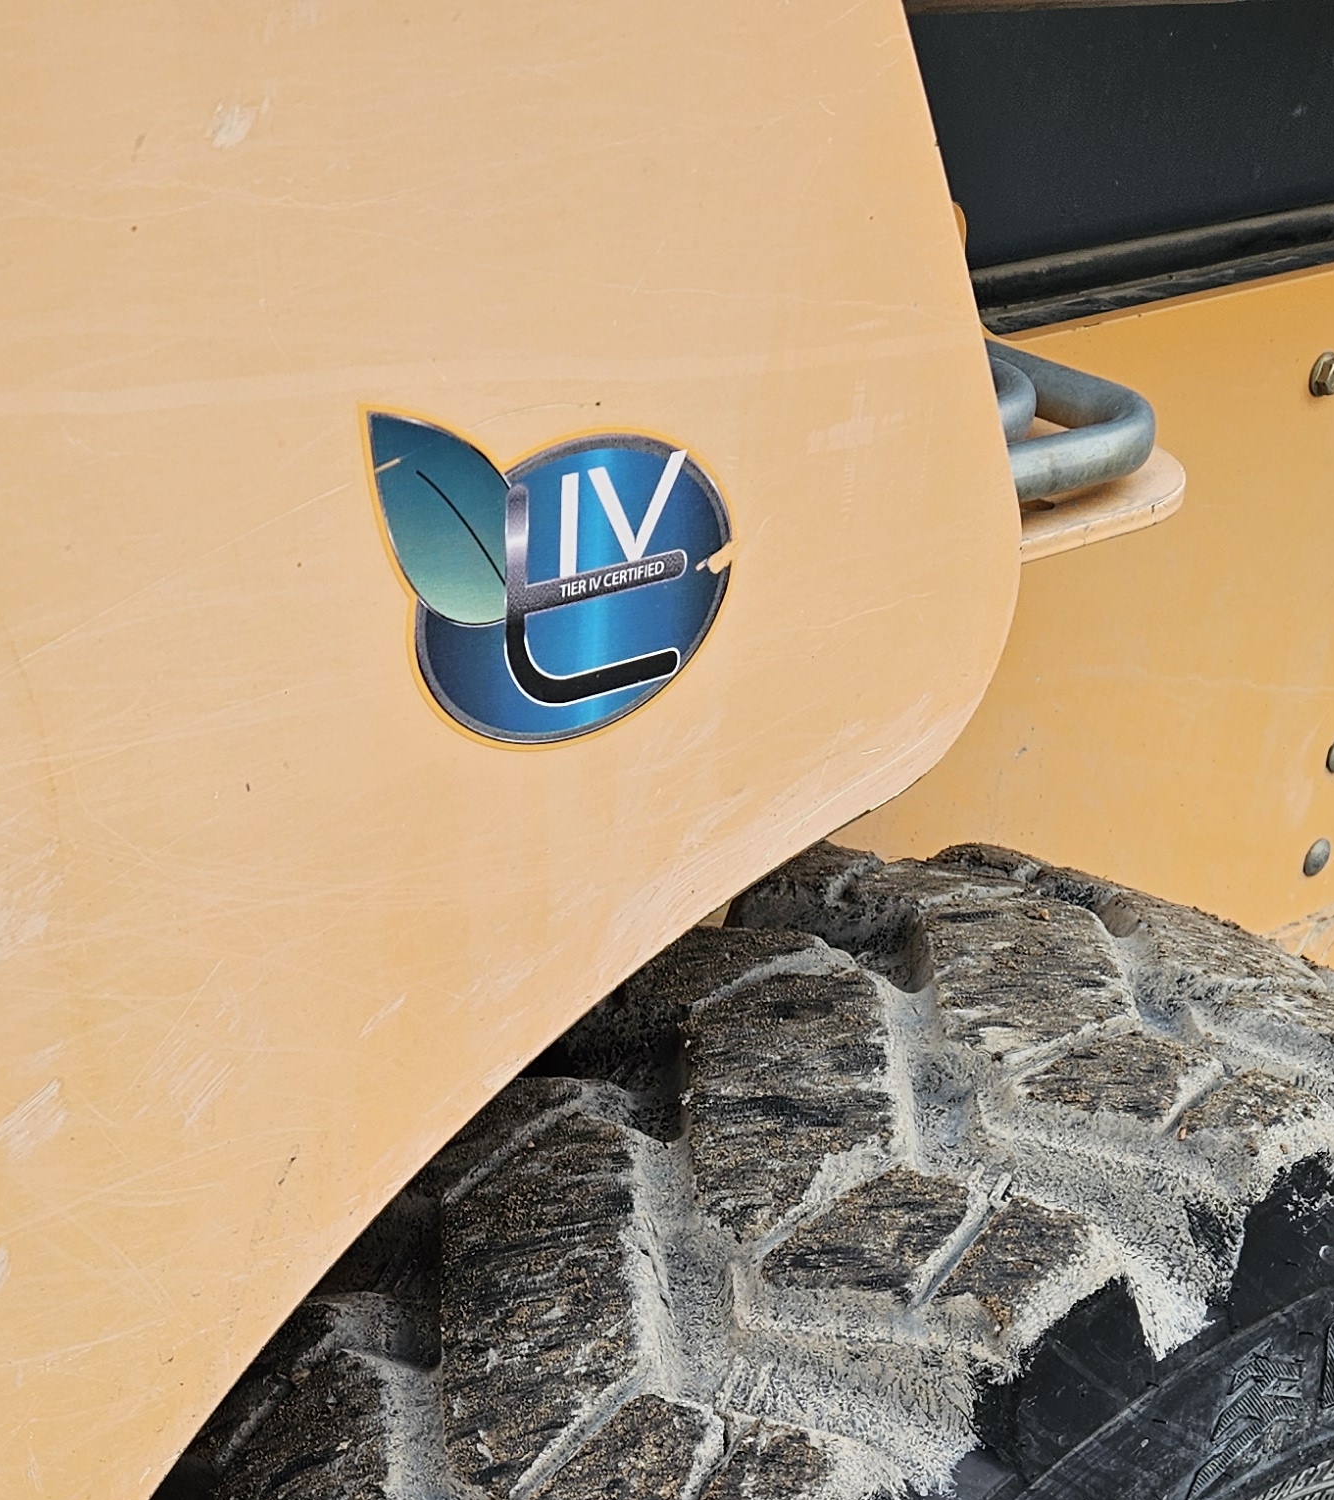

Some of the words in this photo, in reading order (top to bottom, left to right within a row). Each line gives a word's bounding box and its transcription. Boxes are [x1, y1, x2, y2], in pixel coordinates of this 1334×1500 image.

[560, 449, 688, 578] IV
[560, 580, 586, 597] TIER
[589, 576, 602, 591] IV
[603, 560, 665, 587] CERTIFIED
